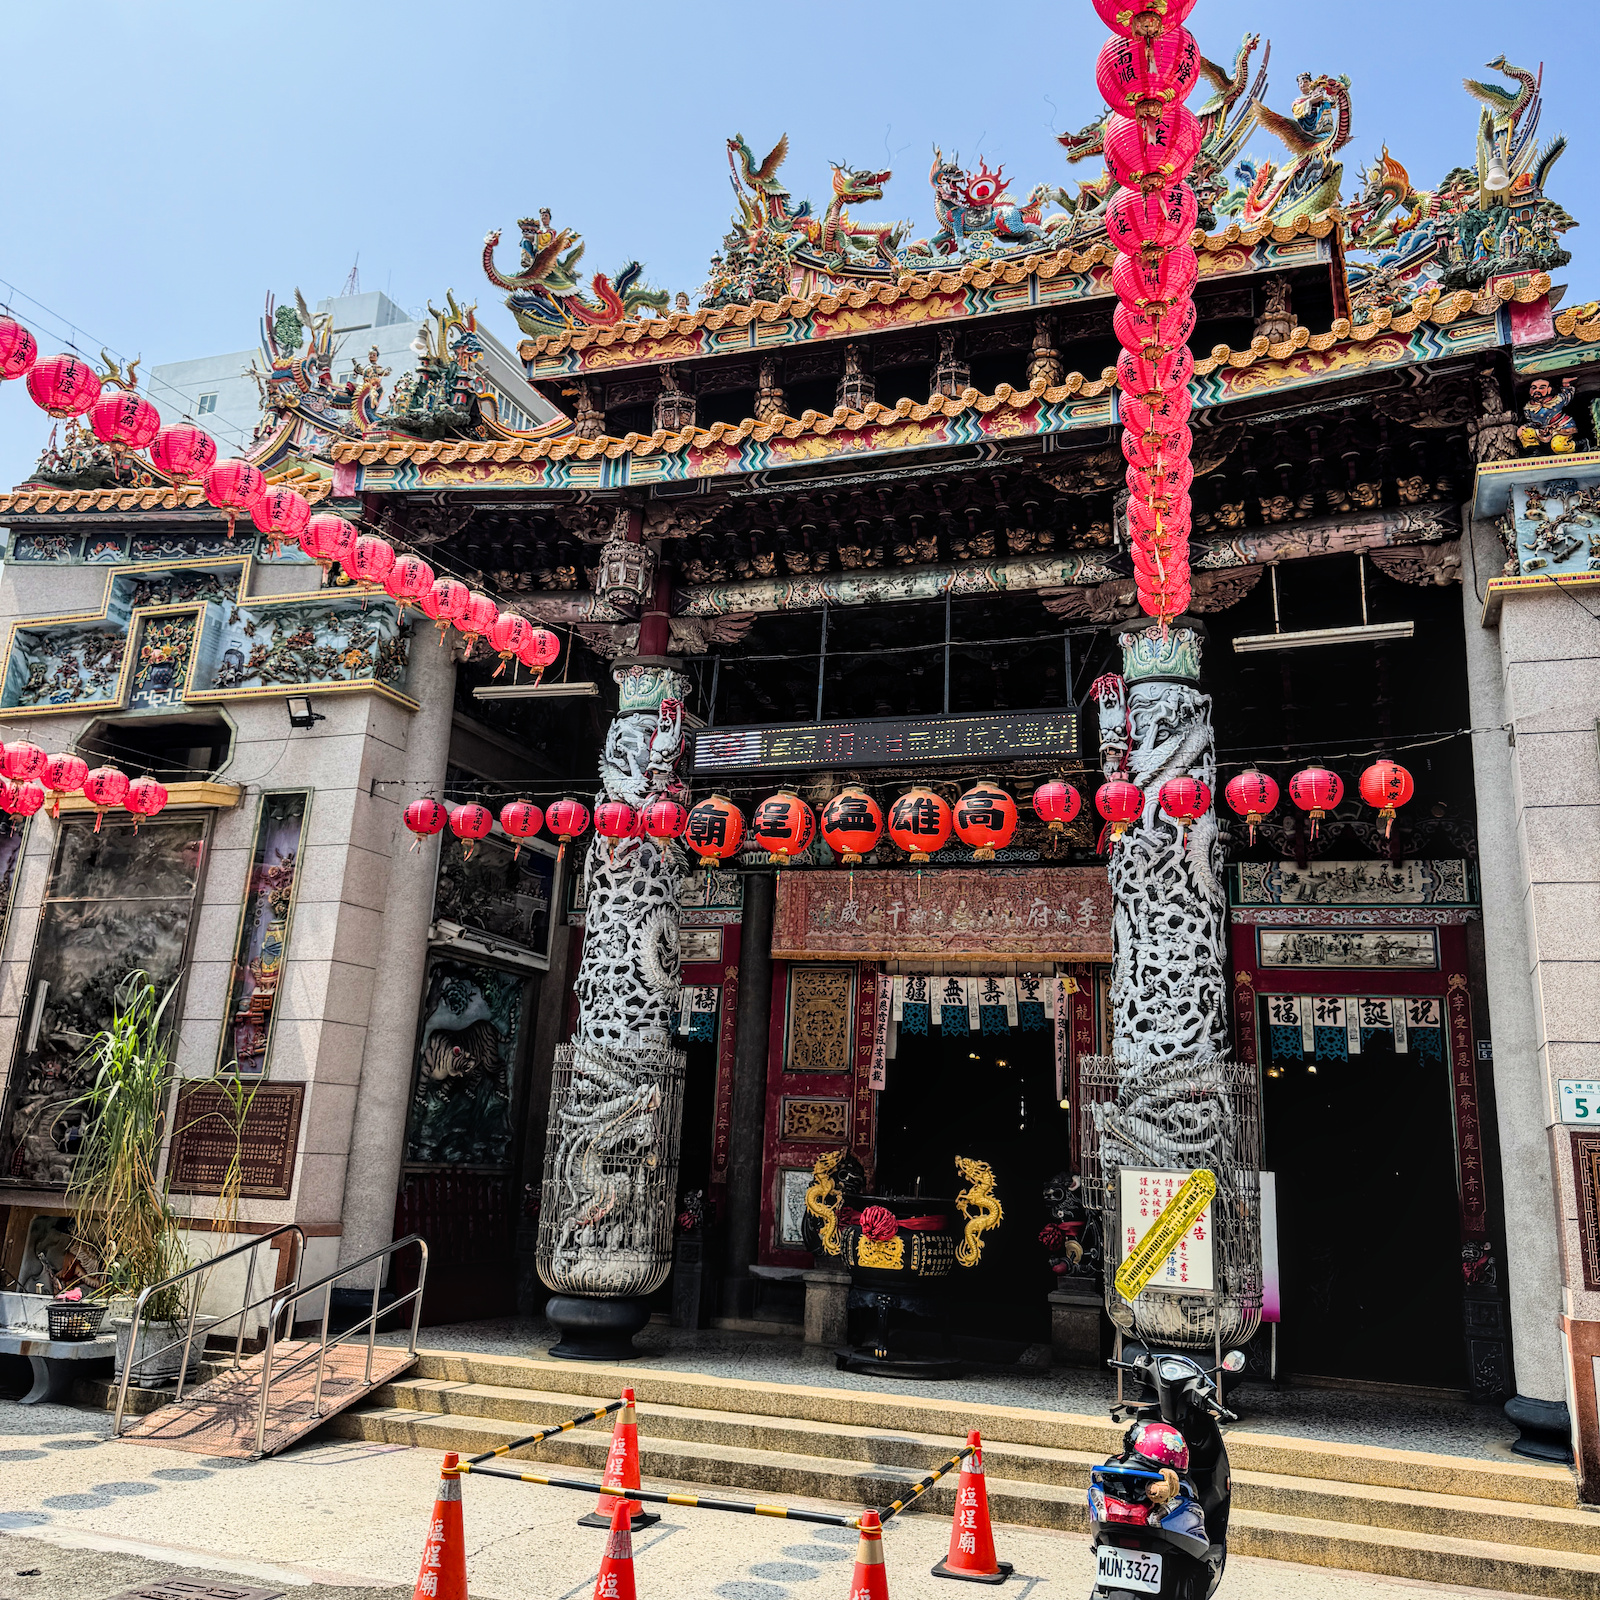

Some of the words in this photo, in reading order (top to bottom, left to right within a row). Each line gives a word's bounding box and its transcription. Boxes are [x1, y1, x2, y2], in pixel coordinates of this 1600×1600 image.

[418, 1518, 446, 1598] 塩埕廟
[957, 1487, 979, 1555] 塩埕廟
